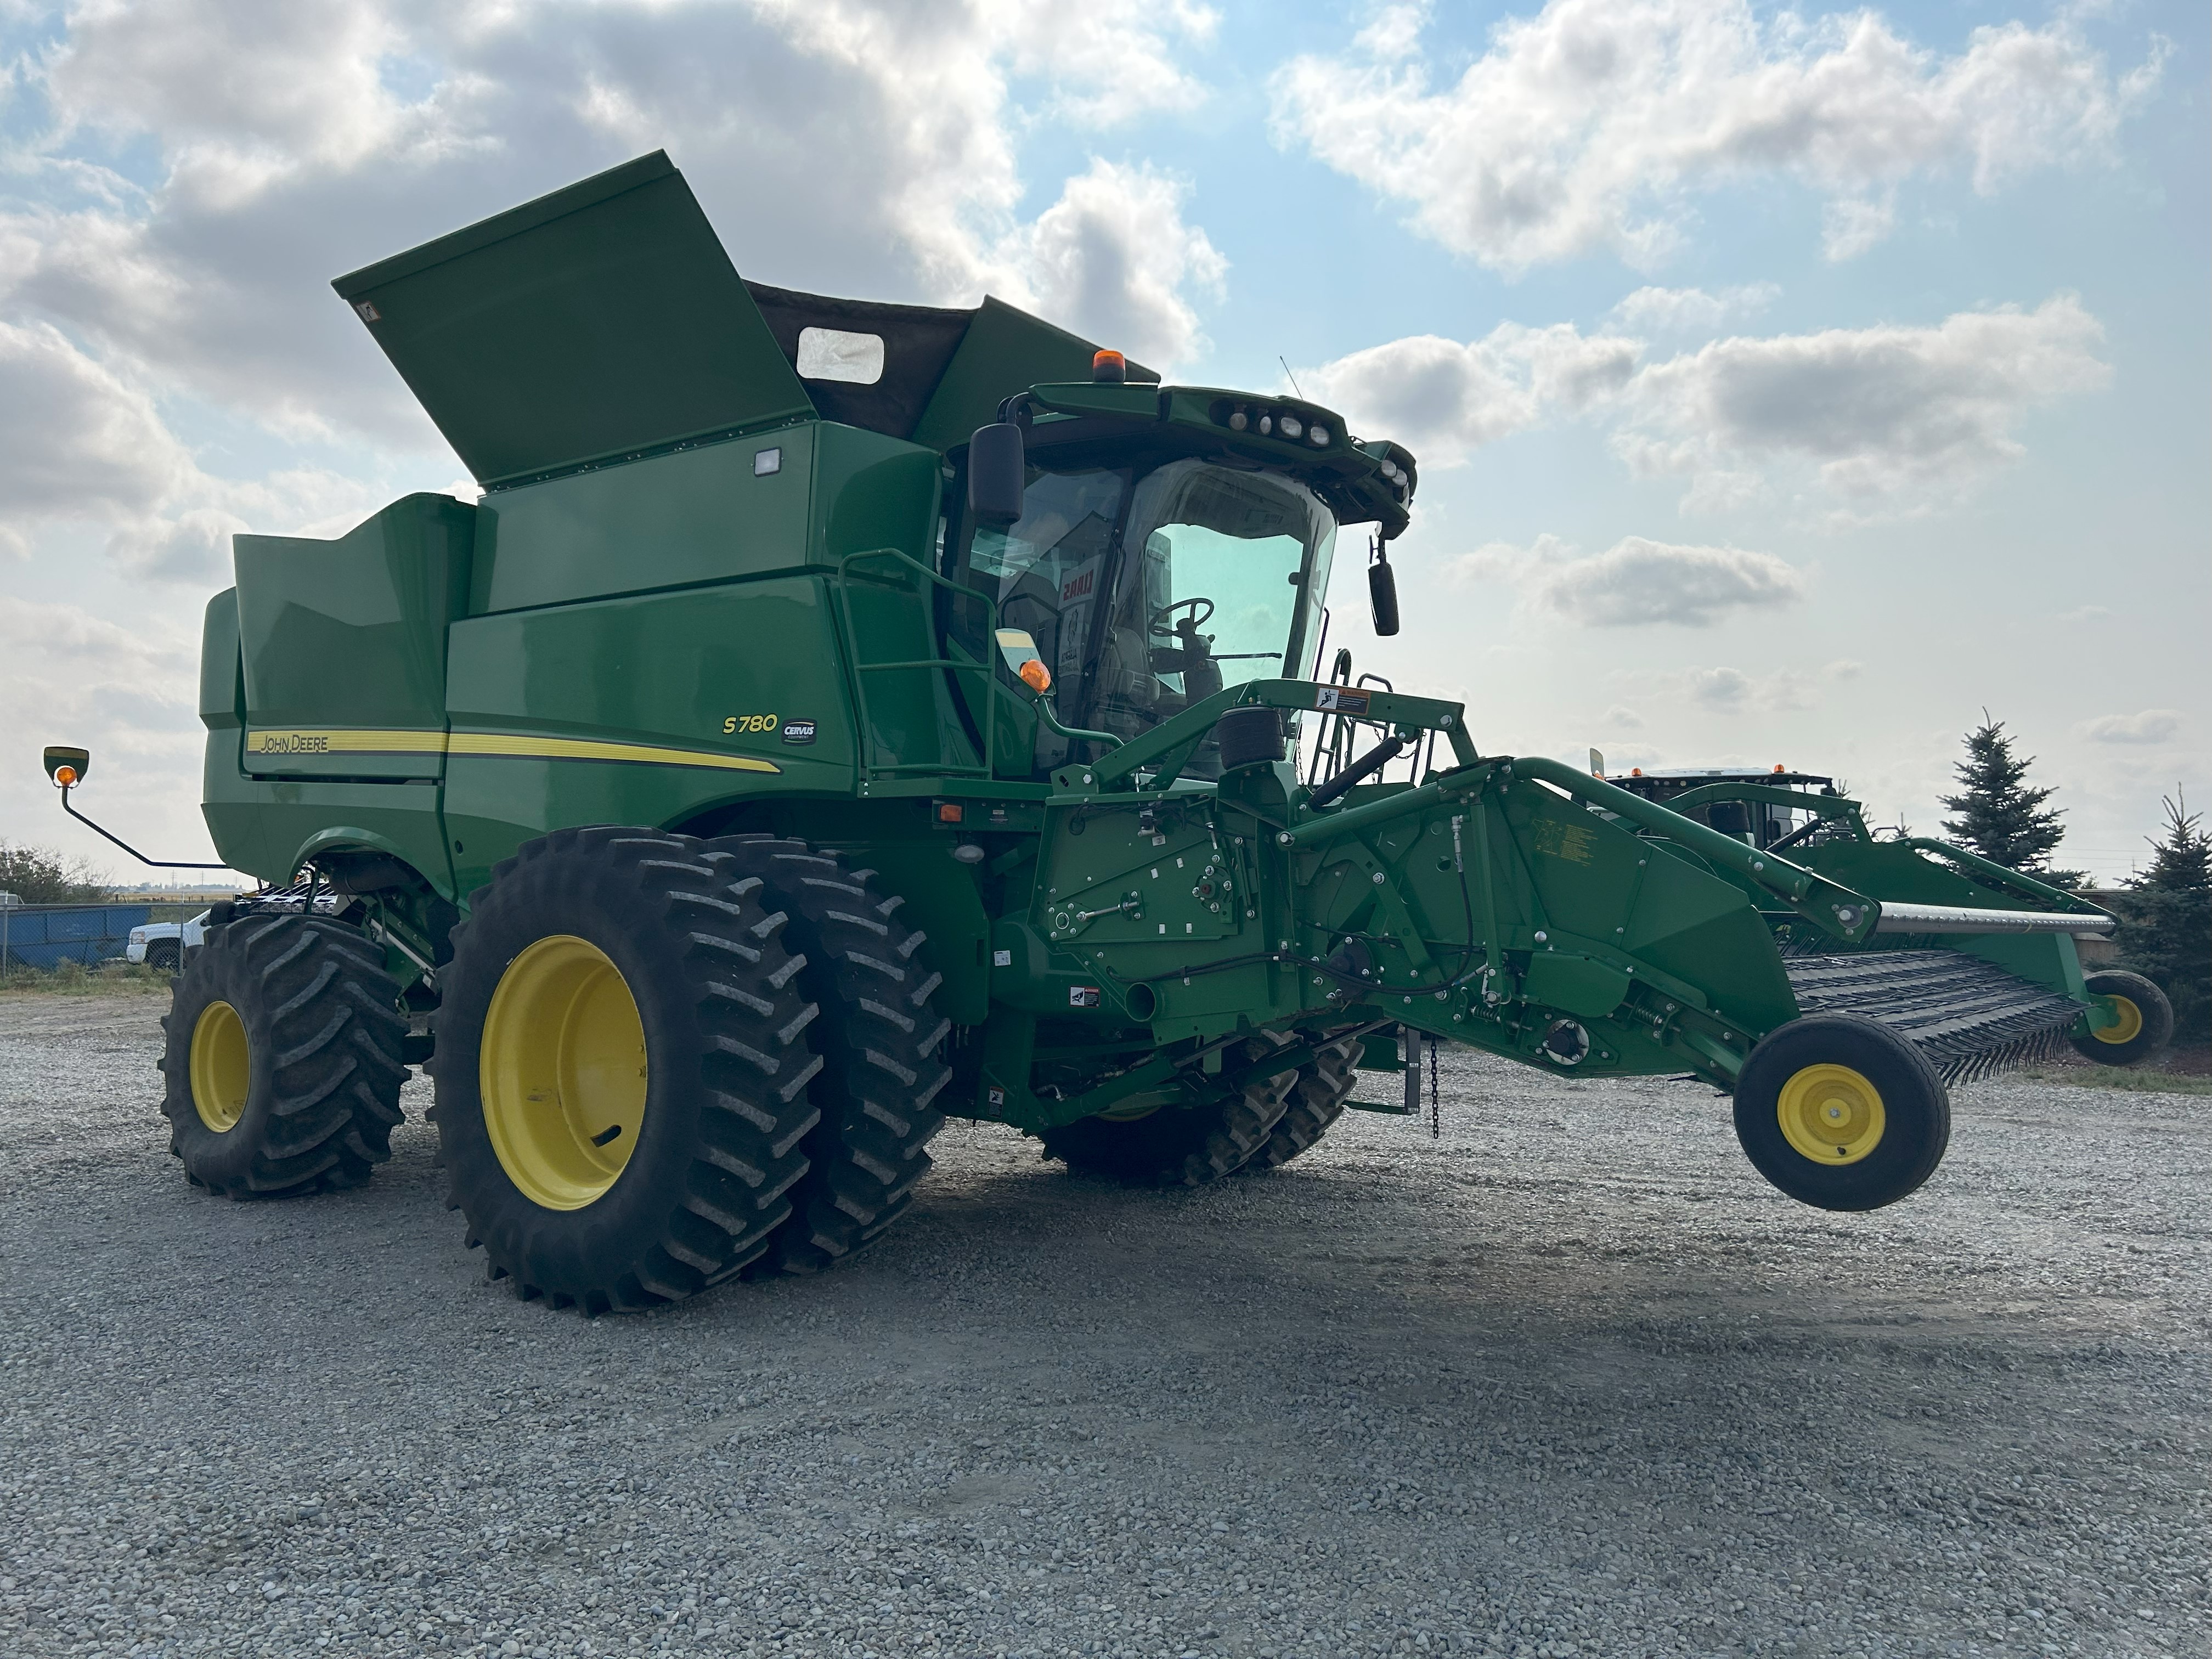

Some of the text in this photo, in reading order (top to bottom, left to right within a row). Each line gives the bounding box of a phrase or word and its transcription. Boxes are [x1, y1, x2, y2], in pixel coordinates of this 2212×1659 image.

[723, 713, 778, 733] S780
[784, 726, 814, 735] CERVUS
[261, 734, 328, 752] JOHN DEERE
